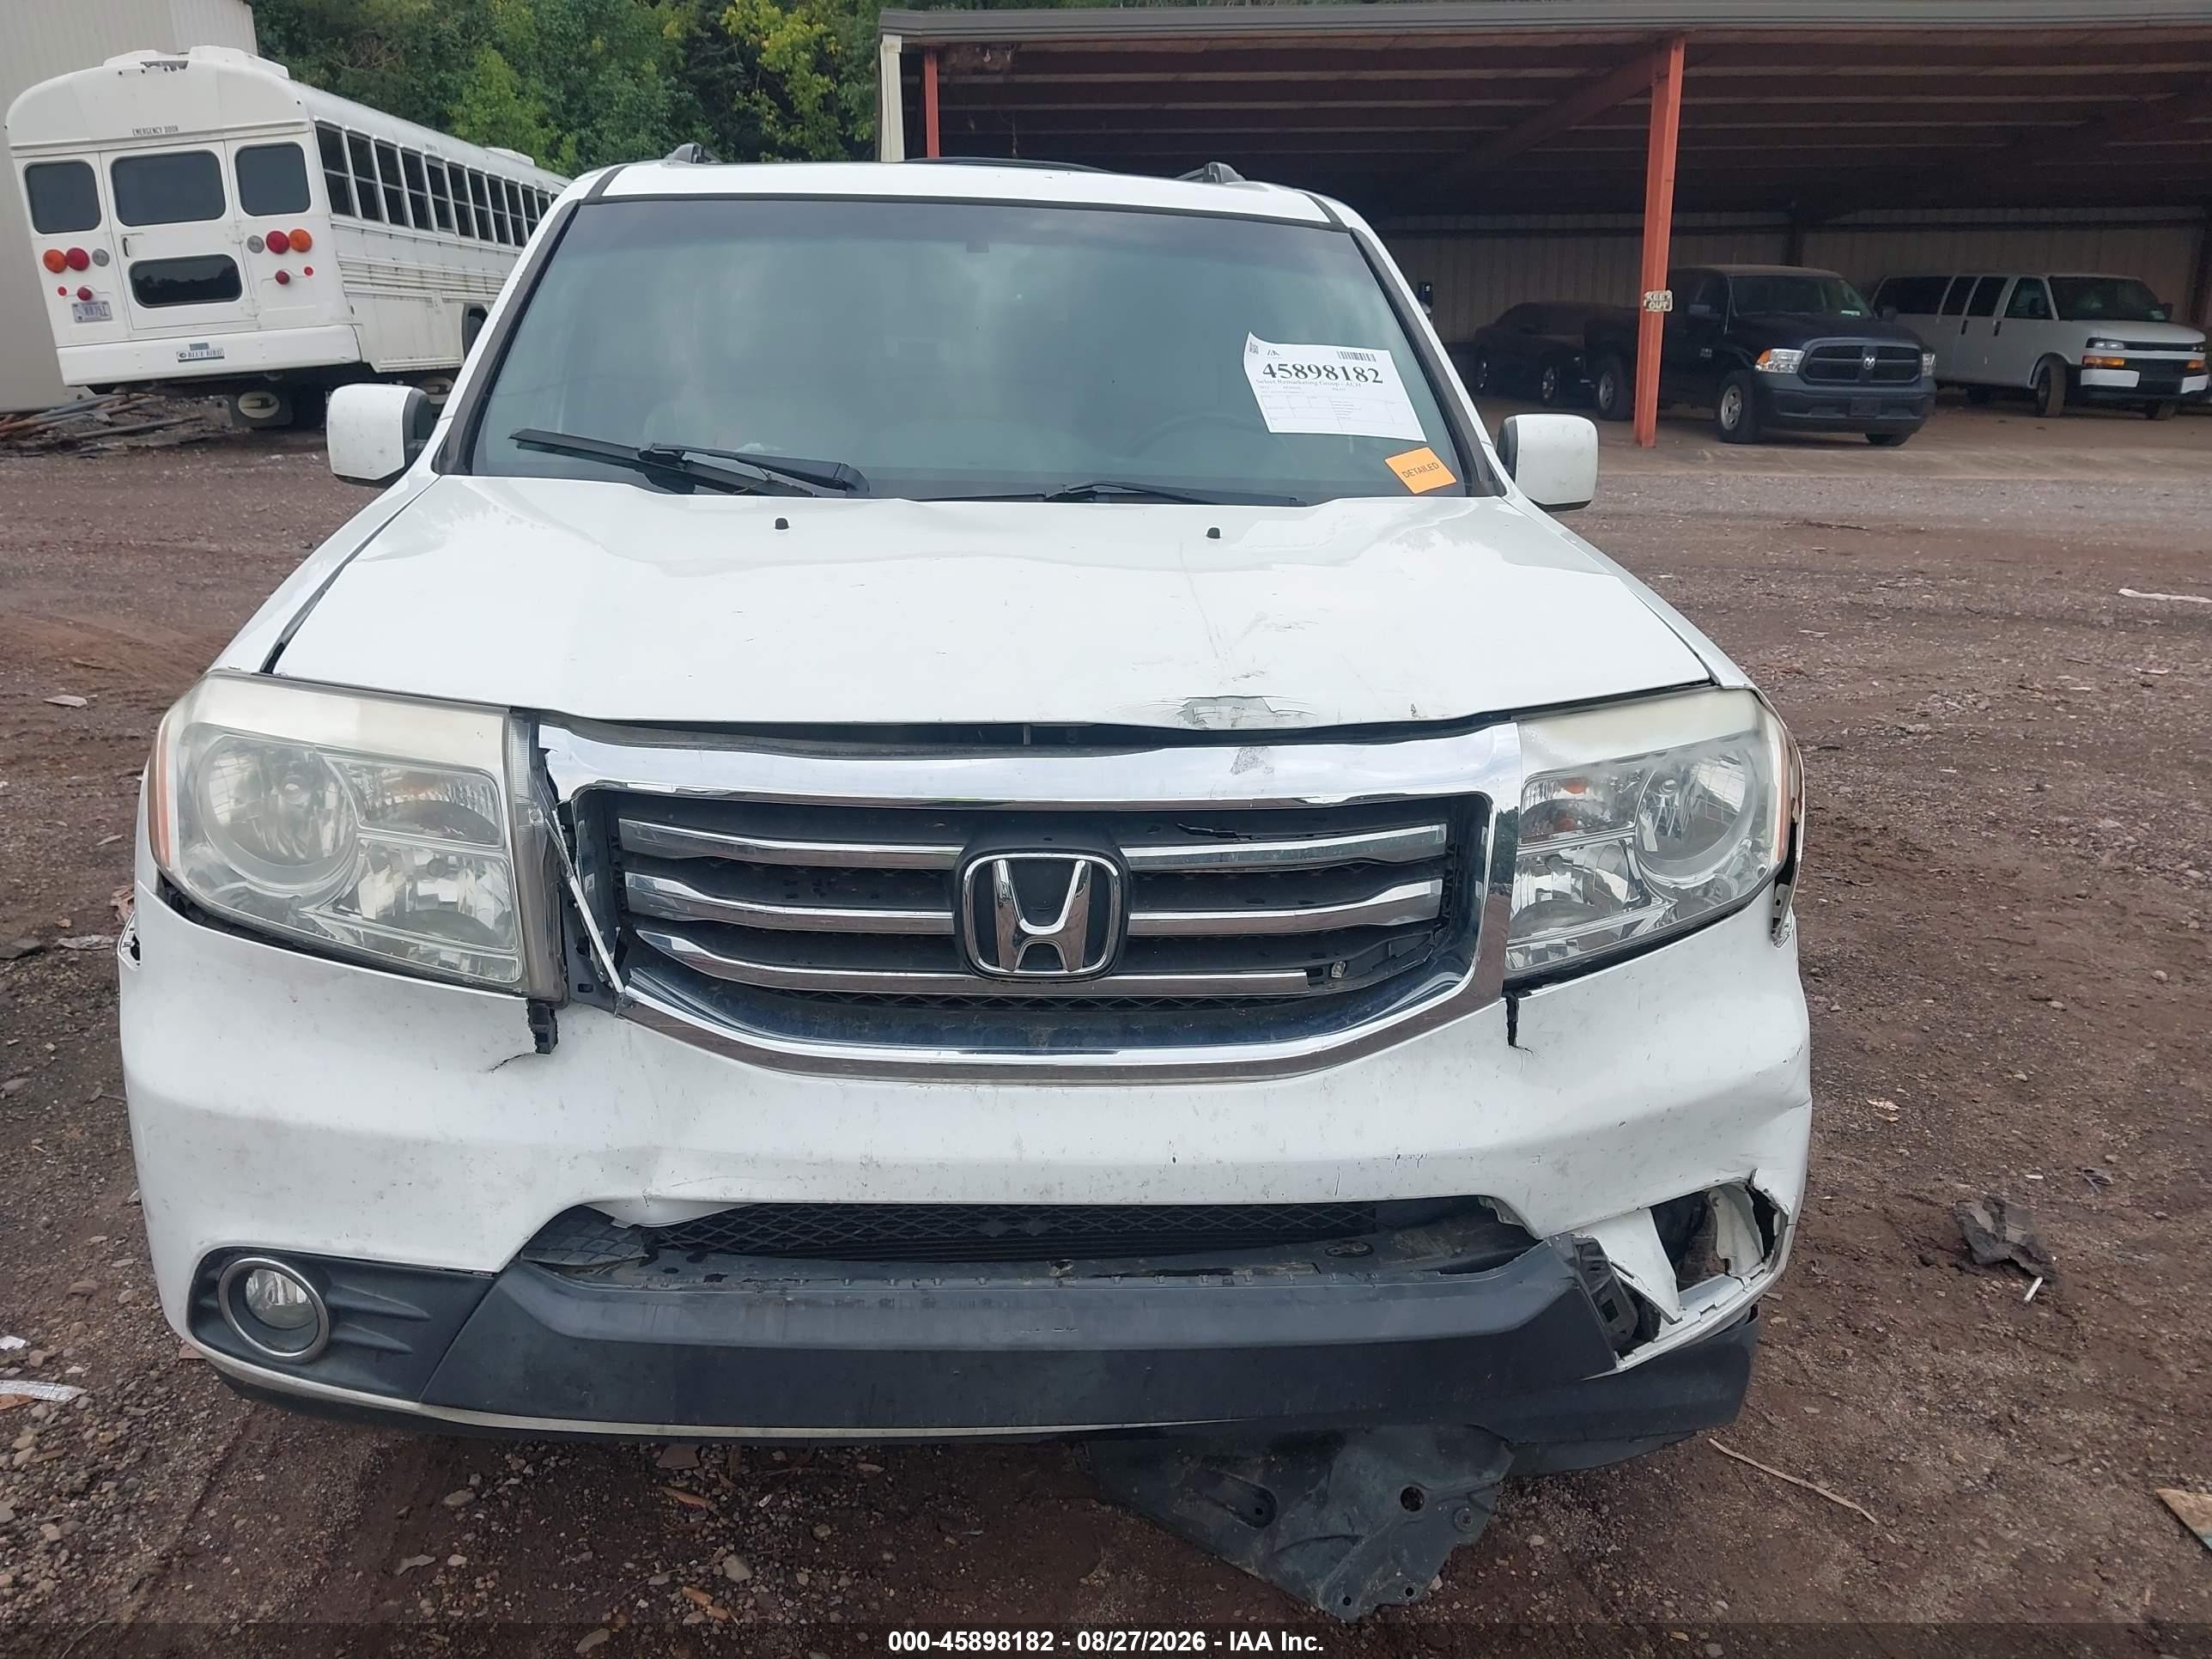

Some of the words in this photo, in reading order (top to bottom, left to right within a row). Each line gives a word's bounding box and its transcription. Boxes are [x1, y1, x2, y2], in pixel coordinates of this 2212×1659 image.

[1648, 301, 1668, 310] OUT
[1262, 363, 1383, 384] 45898182
[1402, 462, 1439, 478] DETAILED
